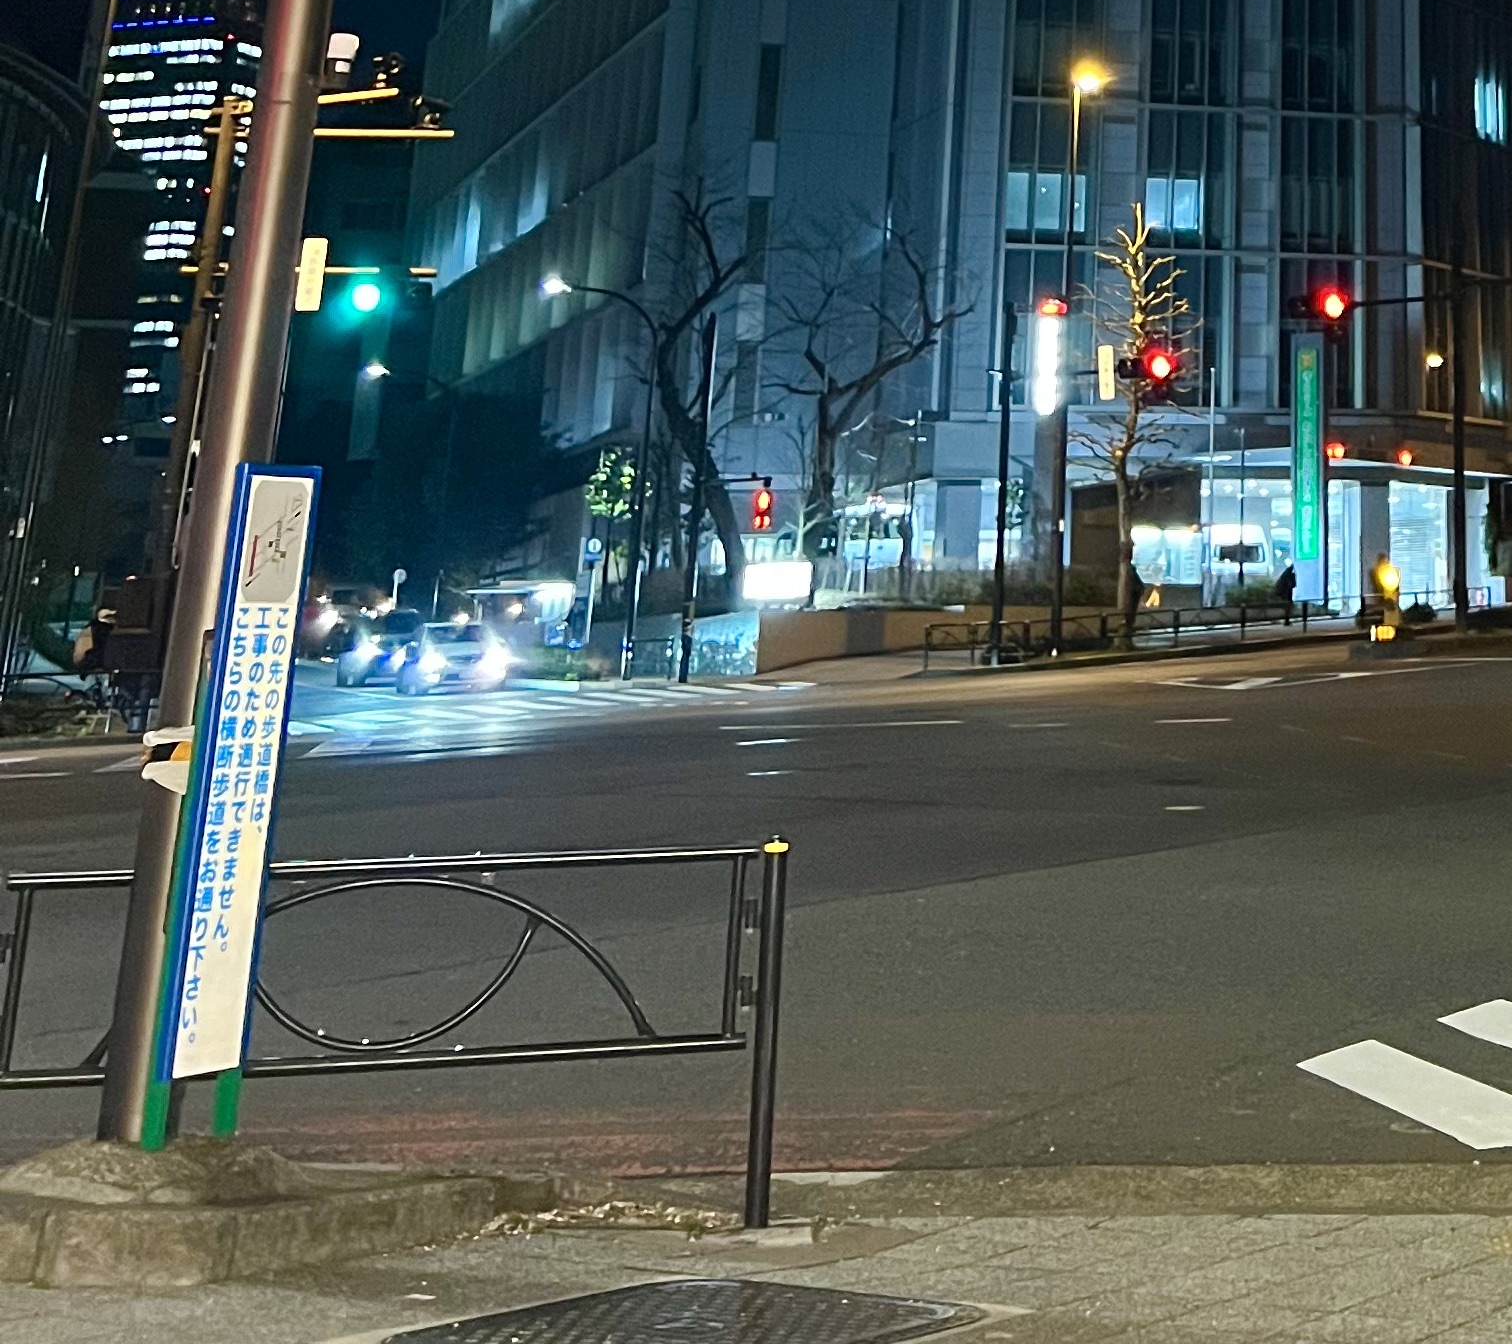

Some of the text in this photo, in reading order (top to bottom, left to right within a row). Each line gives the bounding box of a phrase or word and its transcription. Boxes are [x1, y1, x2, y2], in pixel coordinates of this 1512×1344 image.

[182, 607, 250, 1044] こちらの横断歩道をお通り下さい。
[213, 607, 272, 953] 工事のため通行できません。
[250, 607, 289, 834] この先の歩道橋は、
